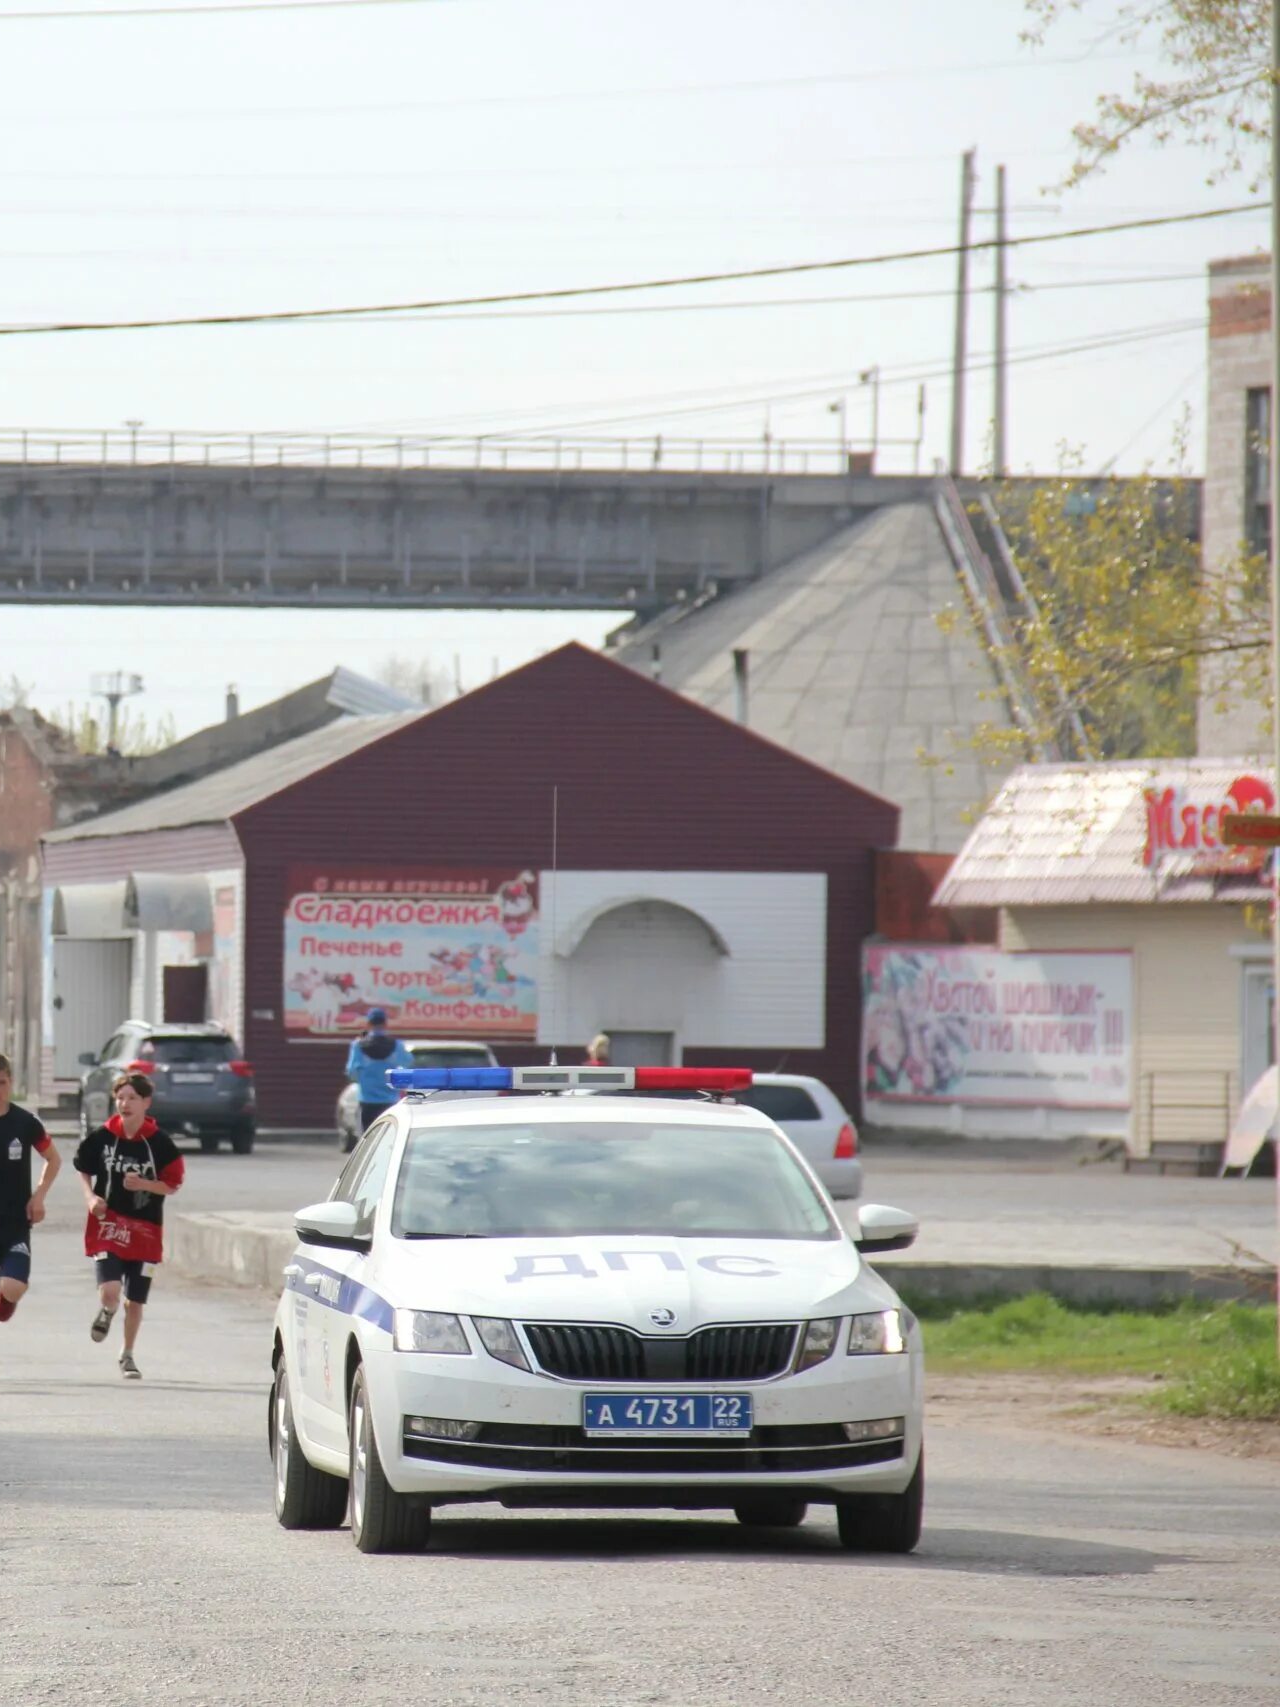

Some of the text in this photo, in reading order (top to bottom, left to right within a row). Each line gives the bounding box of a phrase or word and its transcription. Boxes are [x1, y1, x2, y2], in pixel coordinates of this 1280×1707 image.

[294, 898, 501, 928] Сладкоежка
[299, 937, 403, 957] Печенье
[370, 967, 444, 989] Торты
[403, 999, 518, 1019] Конфеты
[505, 1251, 782, 1284] ДПС
[598, 1398, 741, 1425] А 4731 22
[717, 1418, 738, 1426] RUS
